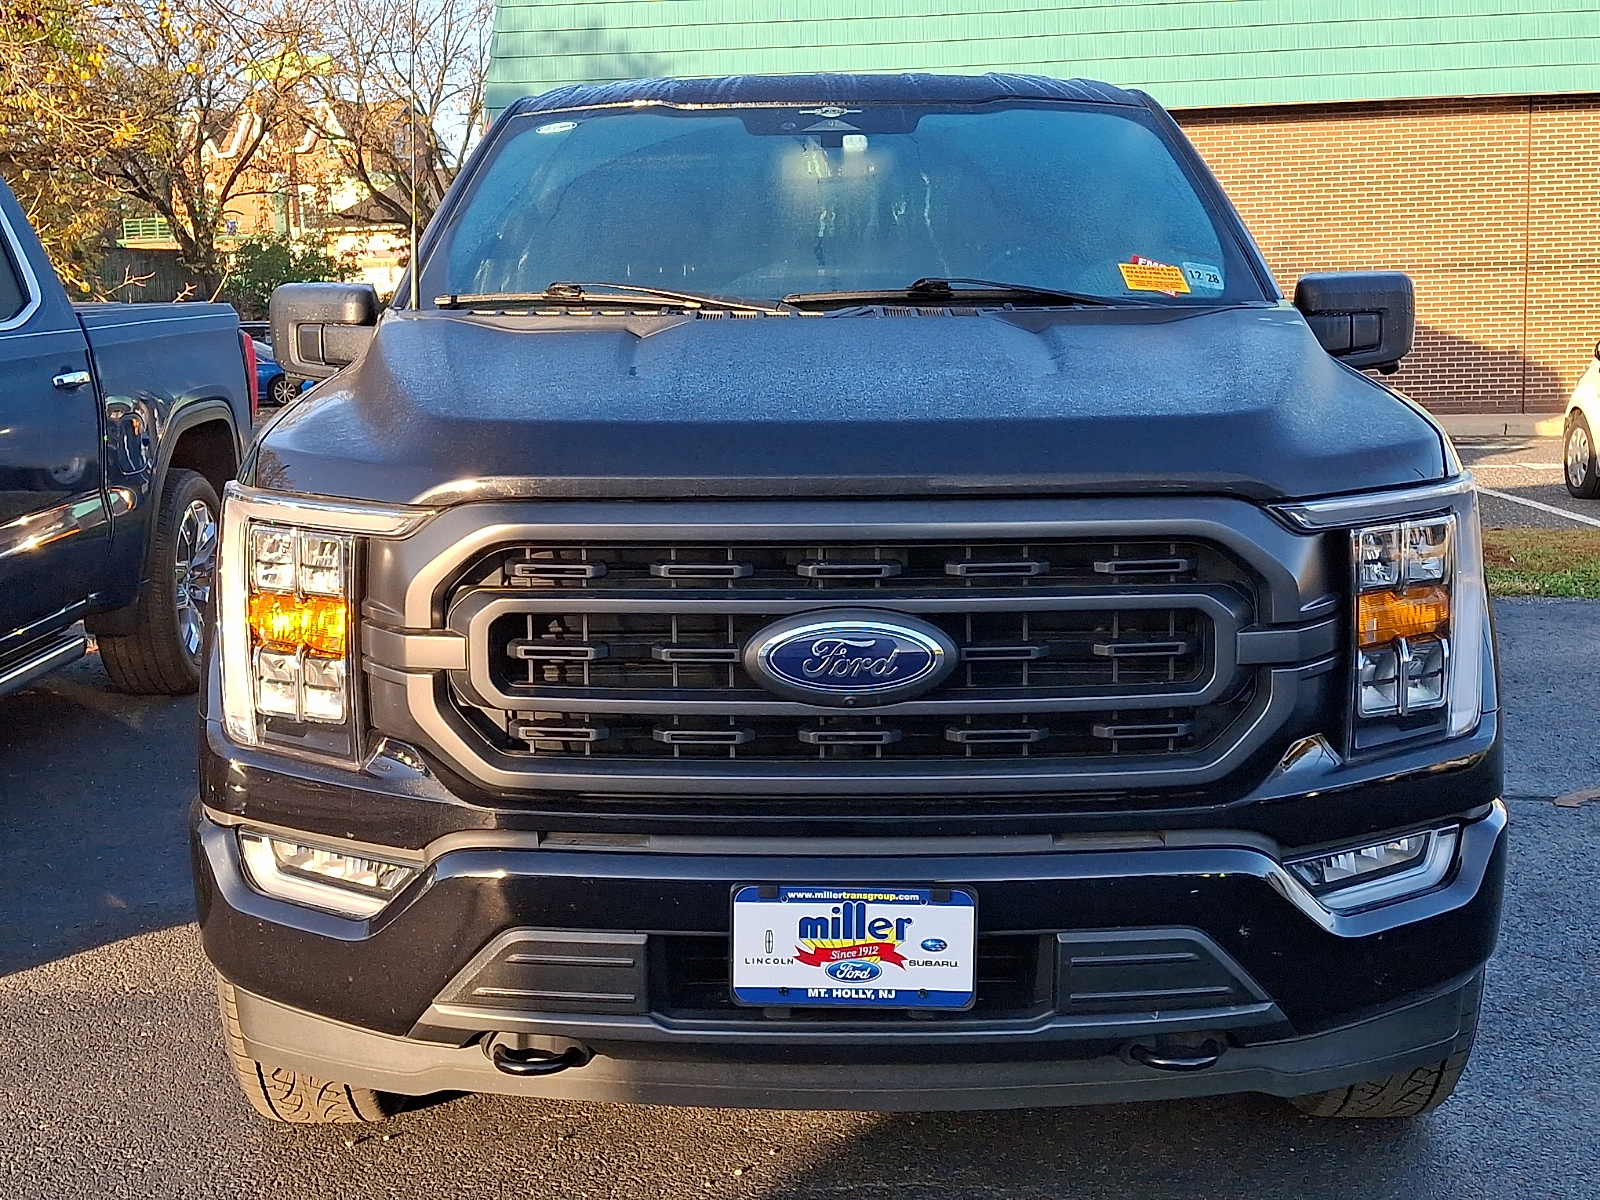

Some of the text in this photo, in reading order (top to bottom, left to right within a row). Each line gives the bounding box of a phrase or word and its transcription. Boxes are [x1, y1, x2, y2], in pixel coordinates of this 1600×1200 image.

[1188, 269, 1202, 280] 12
[1206, 273, 1220, 284] 28
[802, 637, 900, 678] Ford
[787, 890, 920, 902] www.millertransgroup.com
[798, 901, 913, 940] miller
[830, 945, 879, 960] Since 1912
[744, 957, 794, 965] LINCOLN
[908, 959, 957, 968] SUBARU
[836, 961, 871, 979] Ford
[807, 988, 896, 1000] MT. HOLLY, NJ
